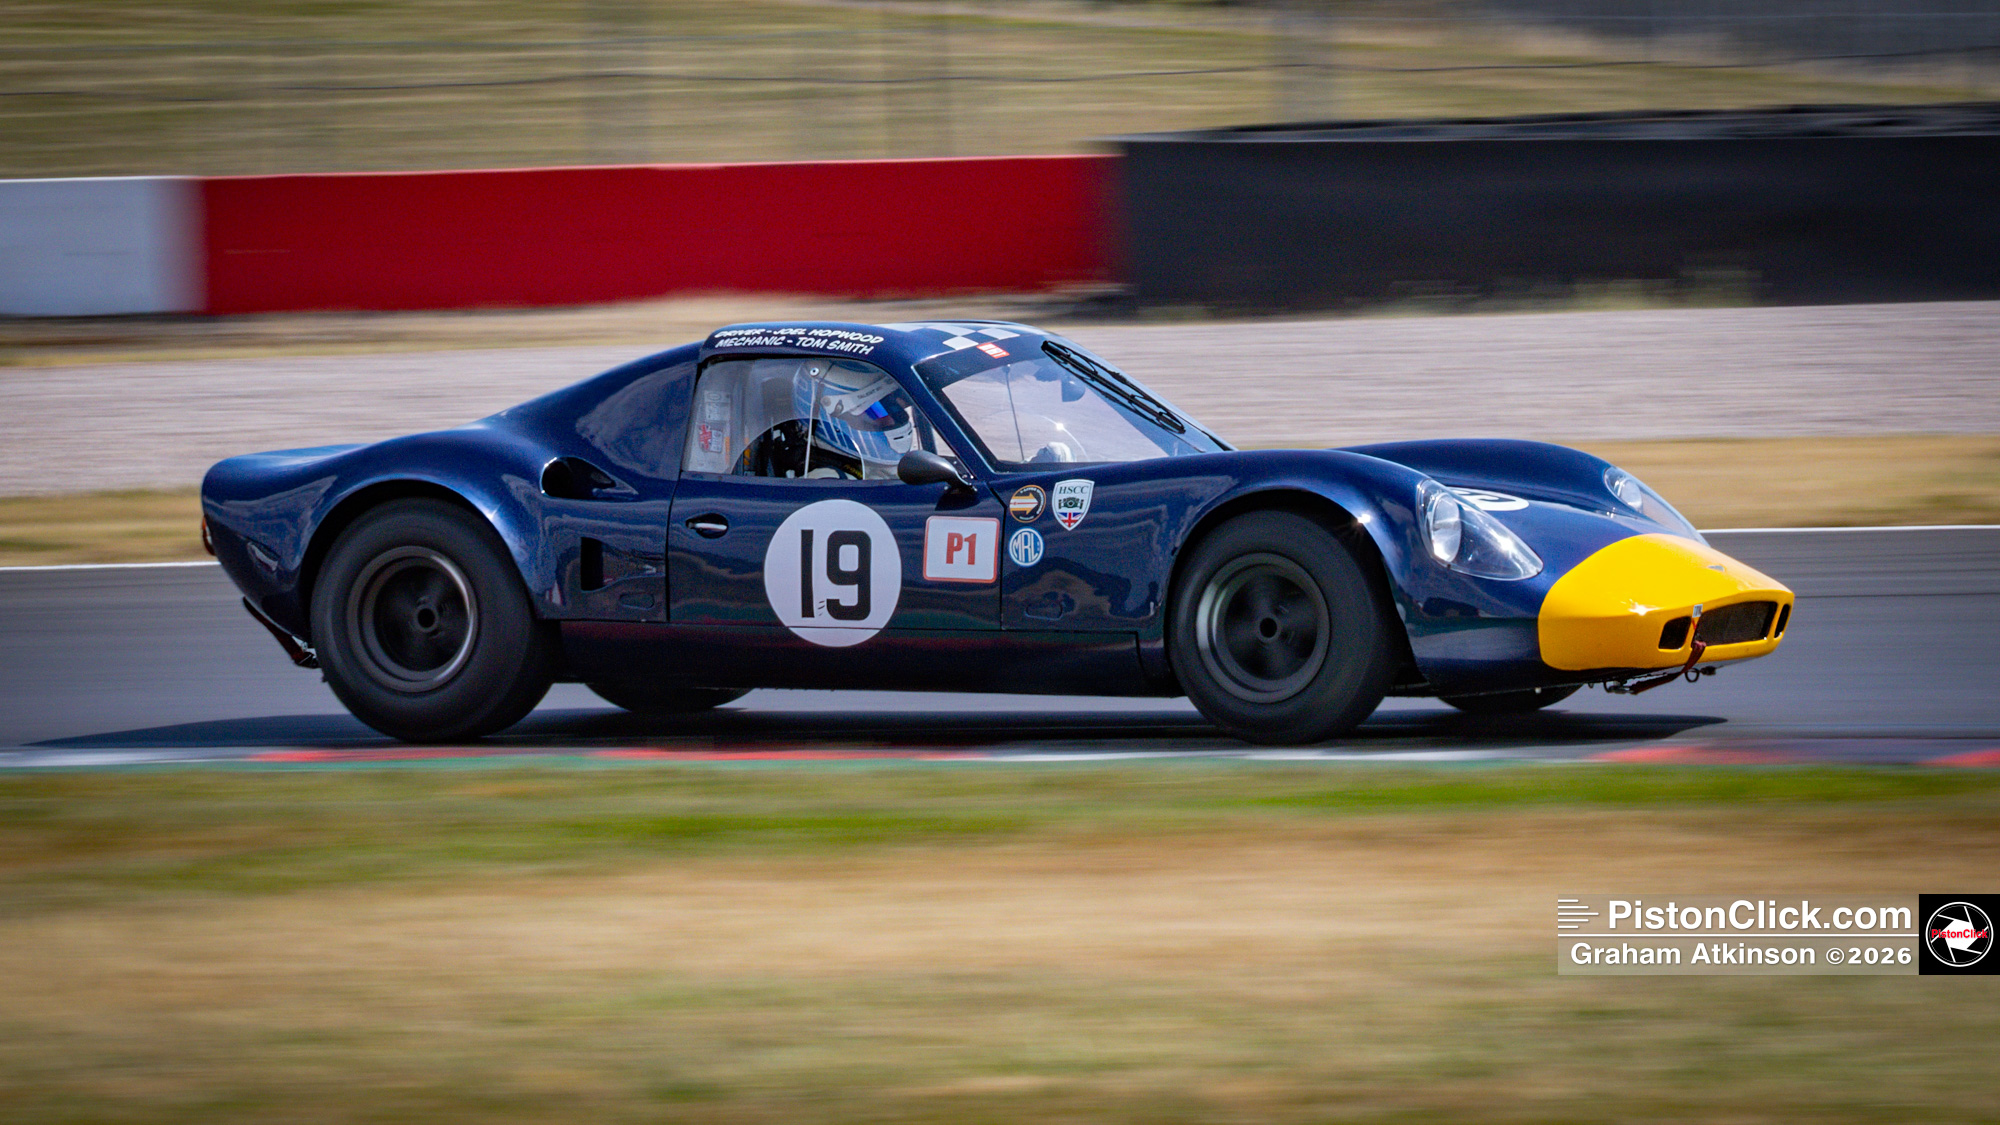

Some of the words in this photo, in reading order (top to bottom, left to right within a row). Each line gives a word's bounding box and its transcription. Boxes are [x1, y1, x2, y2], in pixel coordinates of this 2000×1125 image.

[714, 329, 765, 338] DRIVER
[808, 329, 884, 344] HOPWOOD
[715, 336, 784, 348] MECHANIC
[796, 337, 826, 348] TOM
[827, 340, 875, 355] SMITH
[1059, 486, 1089, 494] HSCC
[945, 532, 977, 565] P1
[1012, 531, 1039, 562] MRL
[801, 529, 872, 621] 19
